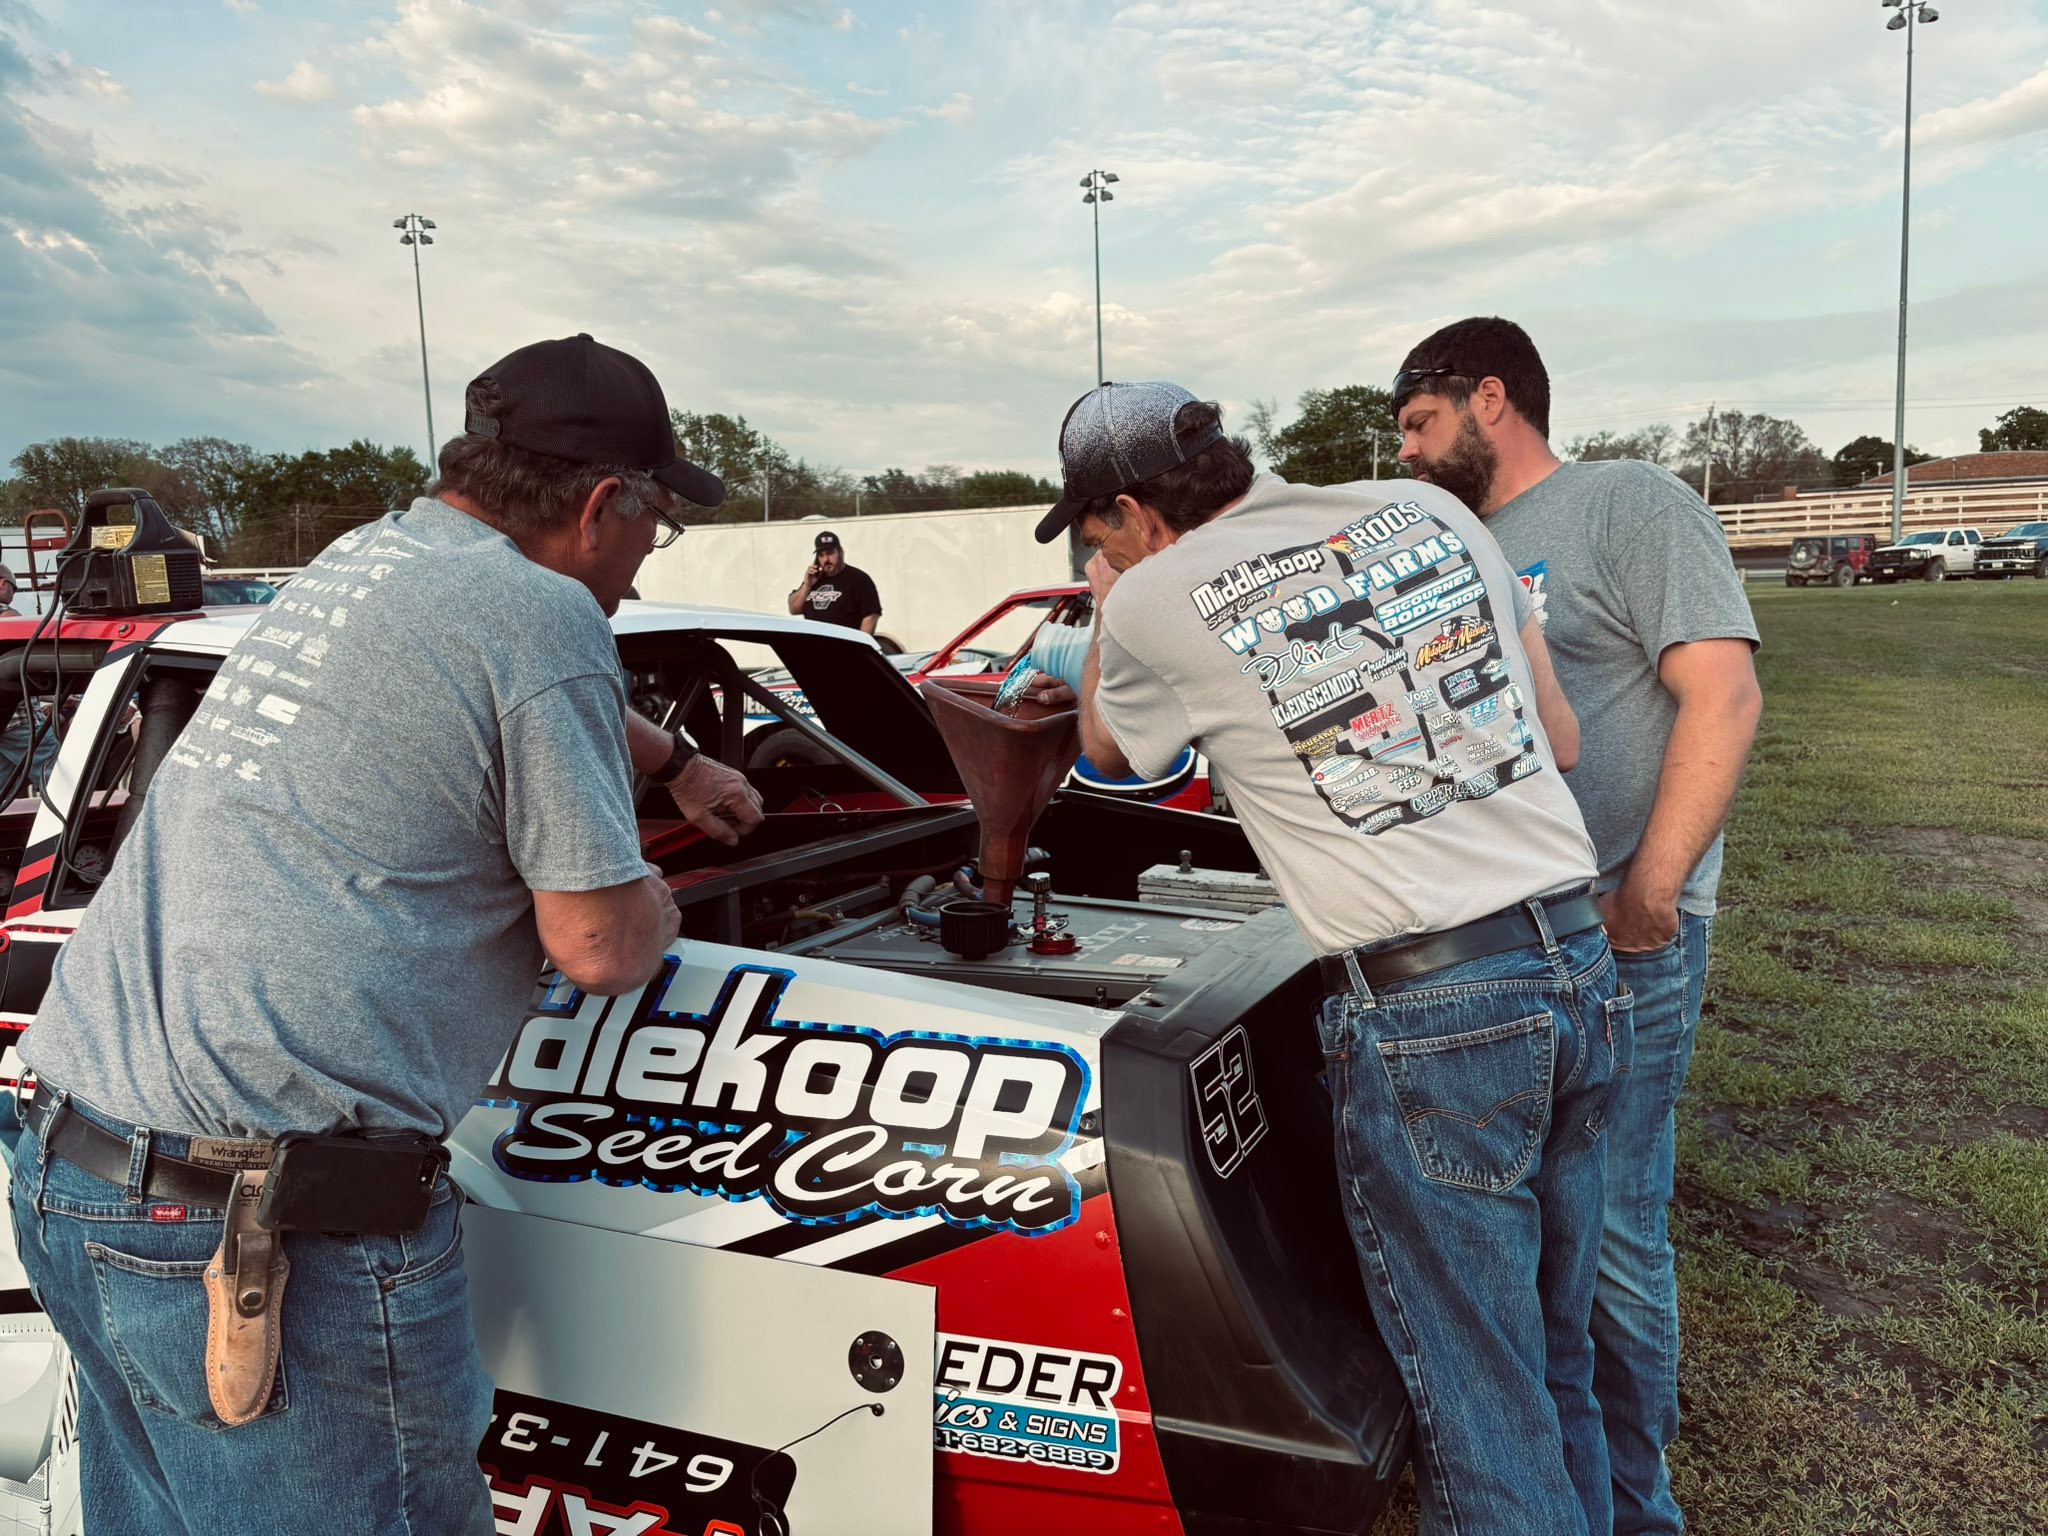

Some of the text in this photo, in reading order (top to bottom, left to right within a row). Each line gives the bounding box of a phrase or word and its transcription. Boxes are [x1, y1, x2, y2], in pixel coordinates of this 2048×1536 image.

[1348, 502, 1430, 548] ROOST
[1190, 550, 1324, 620] Middlekoop
[1343, 531, 1465, 599] FARMS
[1208, 591, 1266, 630] Seed Corn
[1383, 586, 1486, 630] BODY SHOP
[1270, 648, 1407, 729] KLEINSCHMIDT Trucking
[1403, 686, 1435, 704] Vogel
[1351, 703, 1393, 732] MERTZ
[1397, 774, 1422, 793] FEED
[1411, 784, 1454, 811] COPPER
[488, 973, 1067, 1160] dlekoop
[1190, 1024, 1269, 1179] 52
[211, 1145, 266, 1162] Wrangler
[506, 1102, 1056, 1212] Seed Corn
[935, 1340, 1117, 1411] EDER
[935, 1388, 1109, 1444] ics & SIGNS
[493, 1412, 734, 1493] 641-3
[935, 1429, 1110, 1468] 1-682-6889
